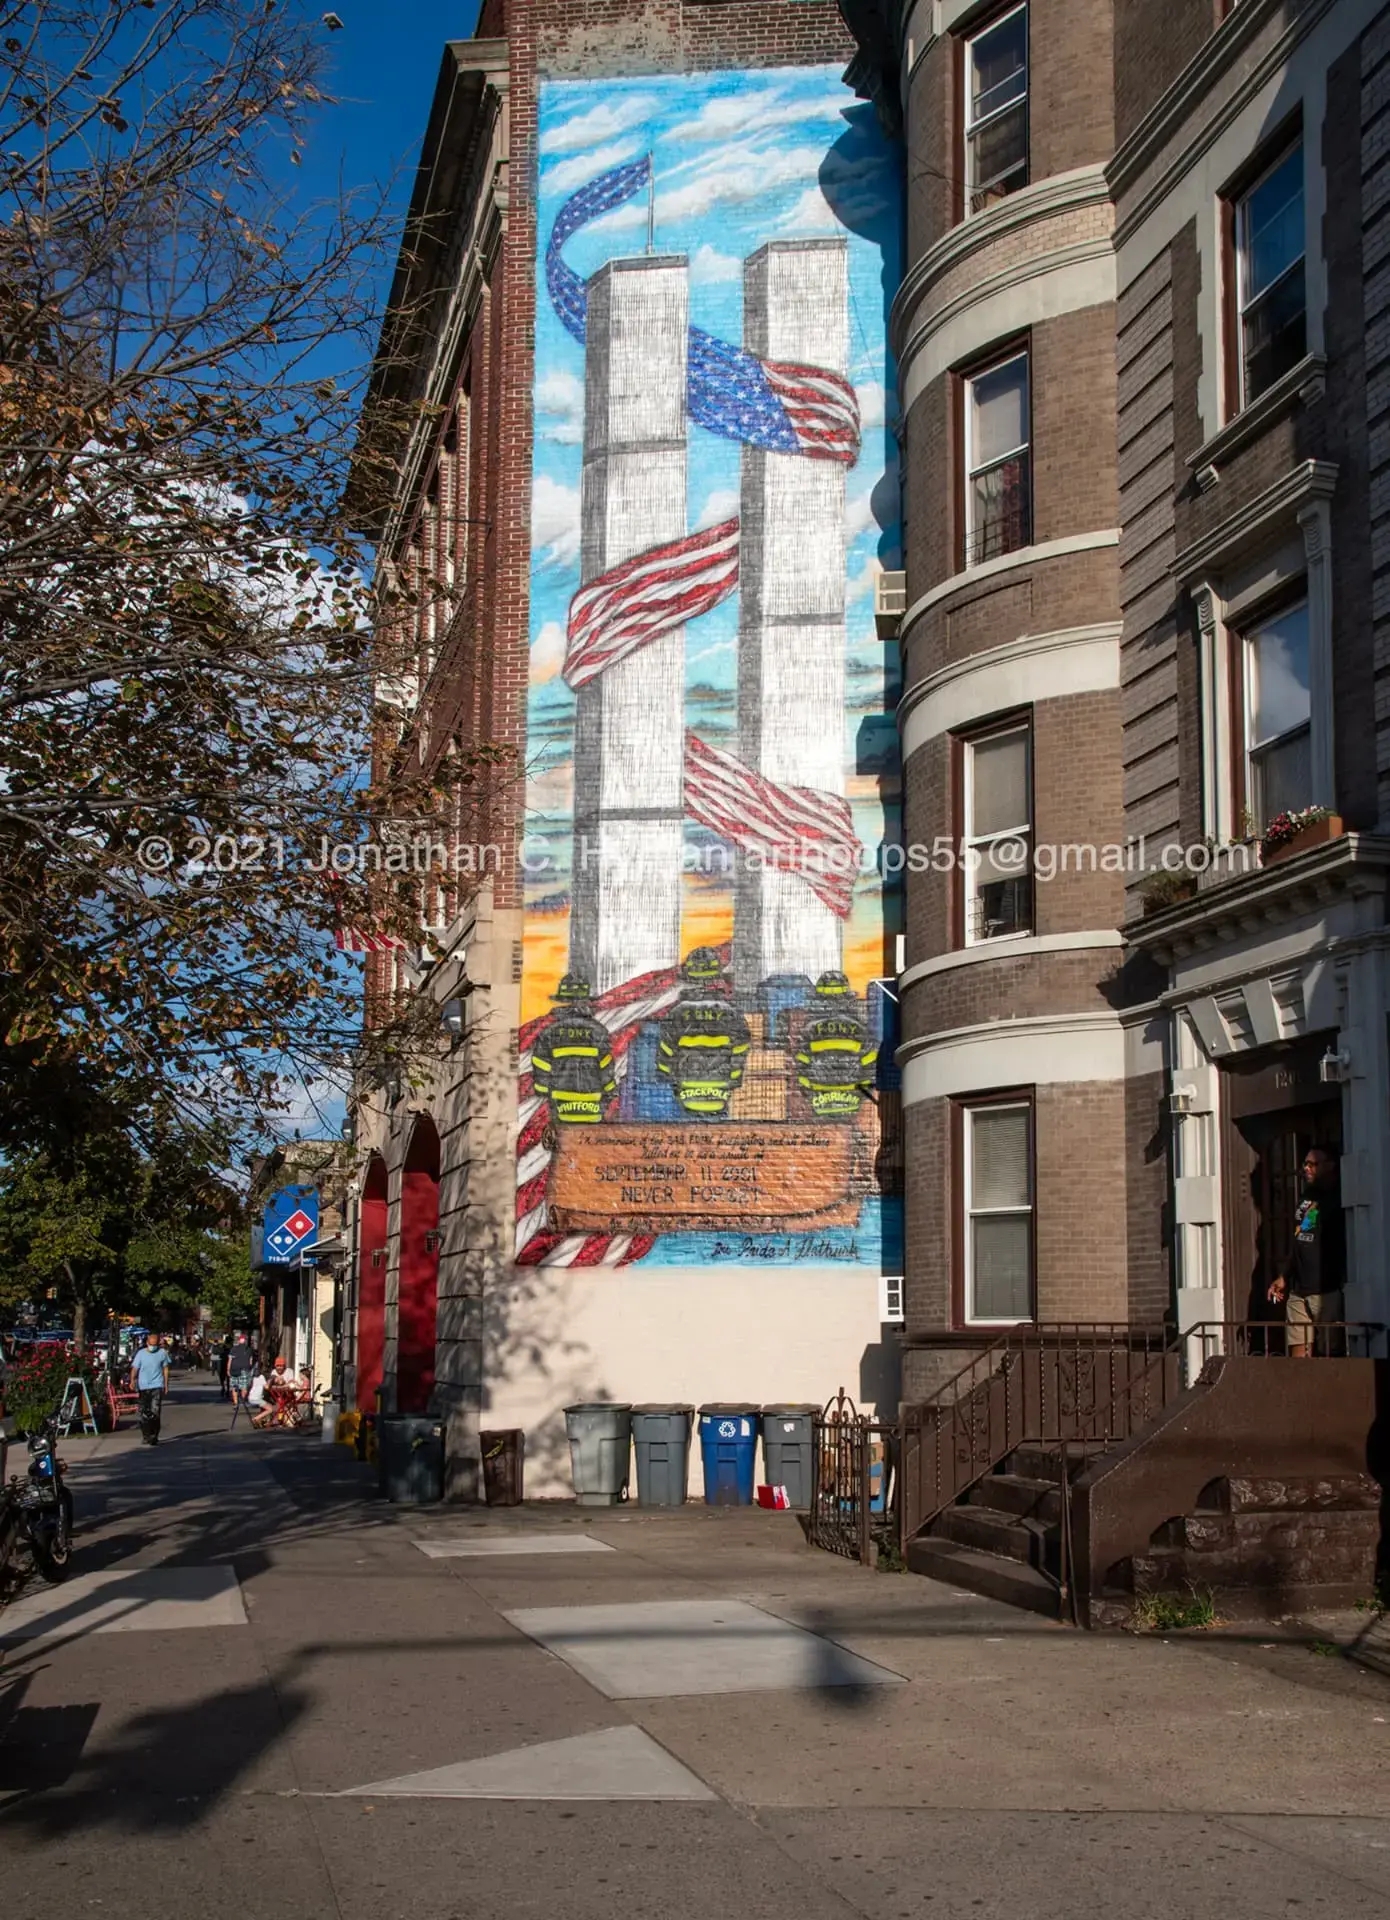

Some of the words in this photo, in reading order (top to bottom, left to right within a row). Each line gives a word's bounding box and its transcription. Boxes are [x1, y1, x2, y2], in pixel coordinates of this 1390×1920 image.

[684, 1009, 723, 1021] FDNY
[559, 1027, 592, 1039] FDNY
[817, 1023, 857, 1034] FDNY
[680, 1087, 729, 1100] STACKPOLE
[812, 1092, 860, 1106] CORRIGAN
[557, 1102, 600, 1113] WHITFORD
[700, 1165, 712, 1182] 11
[720, 1165, 757, 1183] 2001
[620, 1186, 674, 1204] NEVER
[689, 1186, 760, 1204] FORGET
